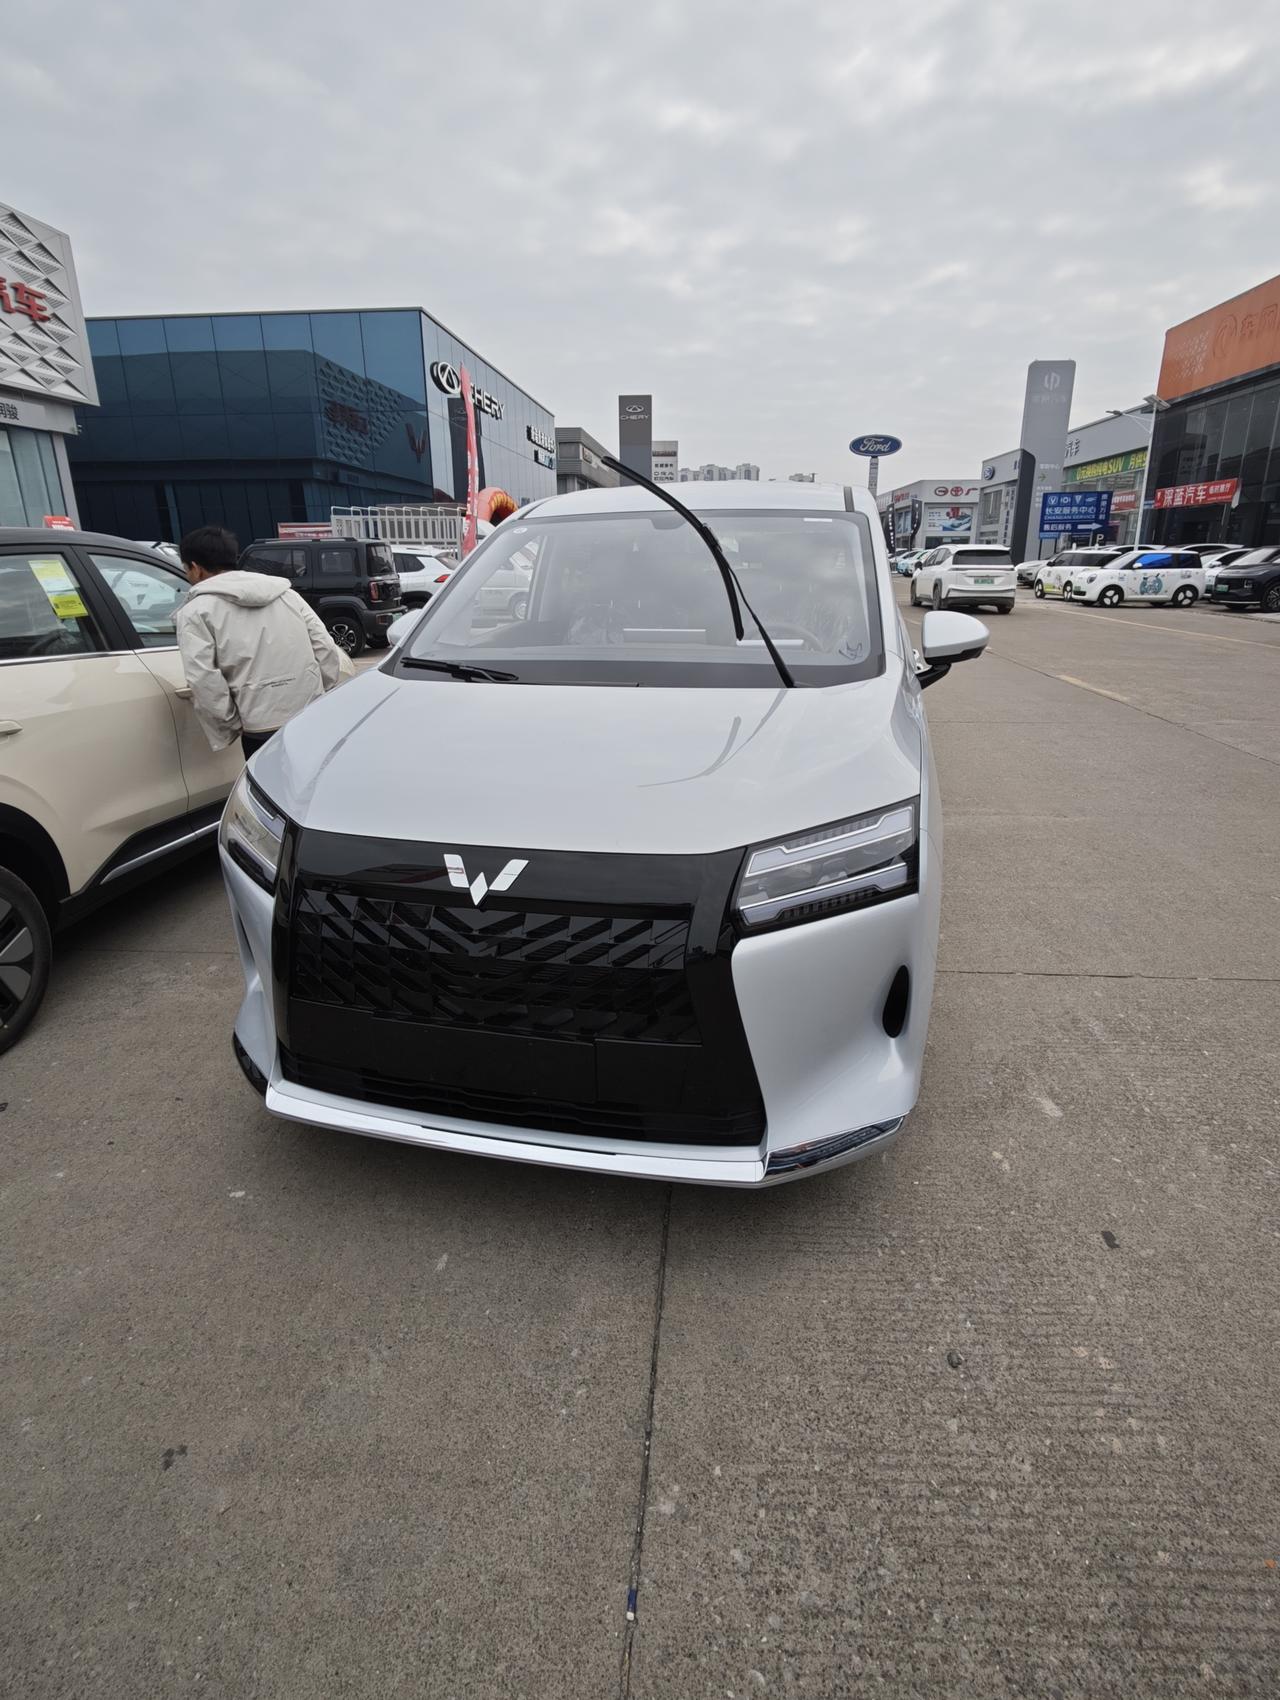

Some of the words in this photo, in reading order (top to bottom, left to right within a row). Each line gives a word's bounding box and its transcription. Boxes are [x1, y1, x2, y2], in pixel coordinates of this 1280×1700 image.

[860, 437, 891, 452] Ford
[1162, 484, 1208, 507] 深蓝汽车
[1046, 506, 1096, 514] 长安服务中心
[1096, 533, 1105, 543] P
